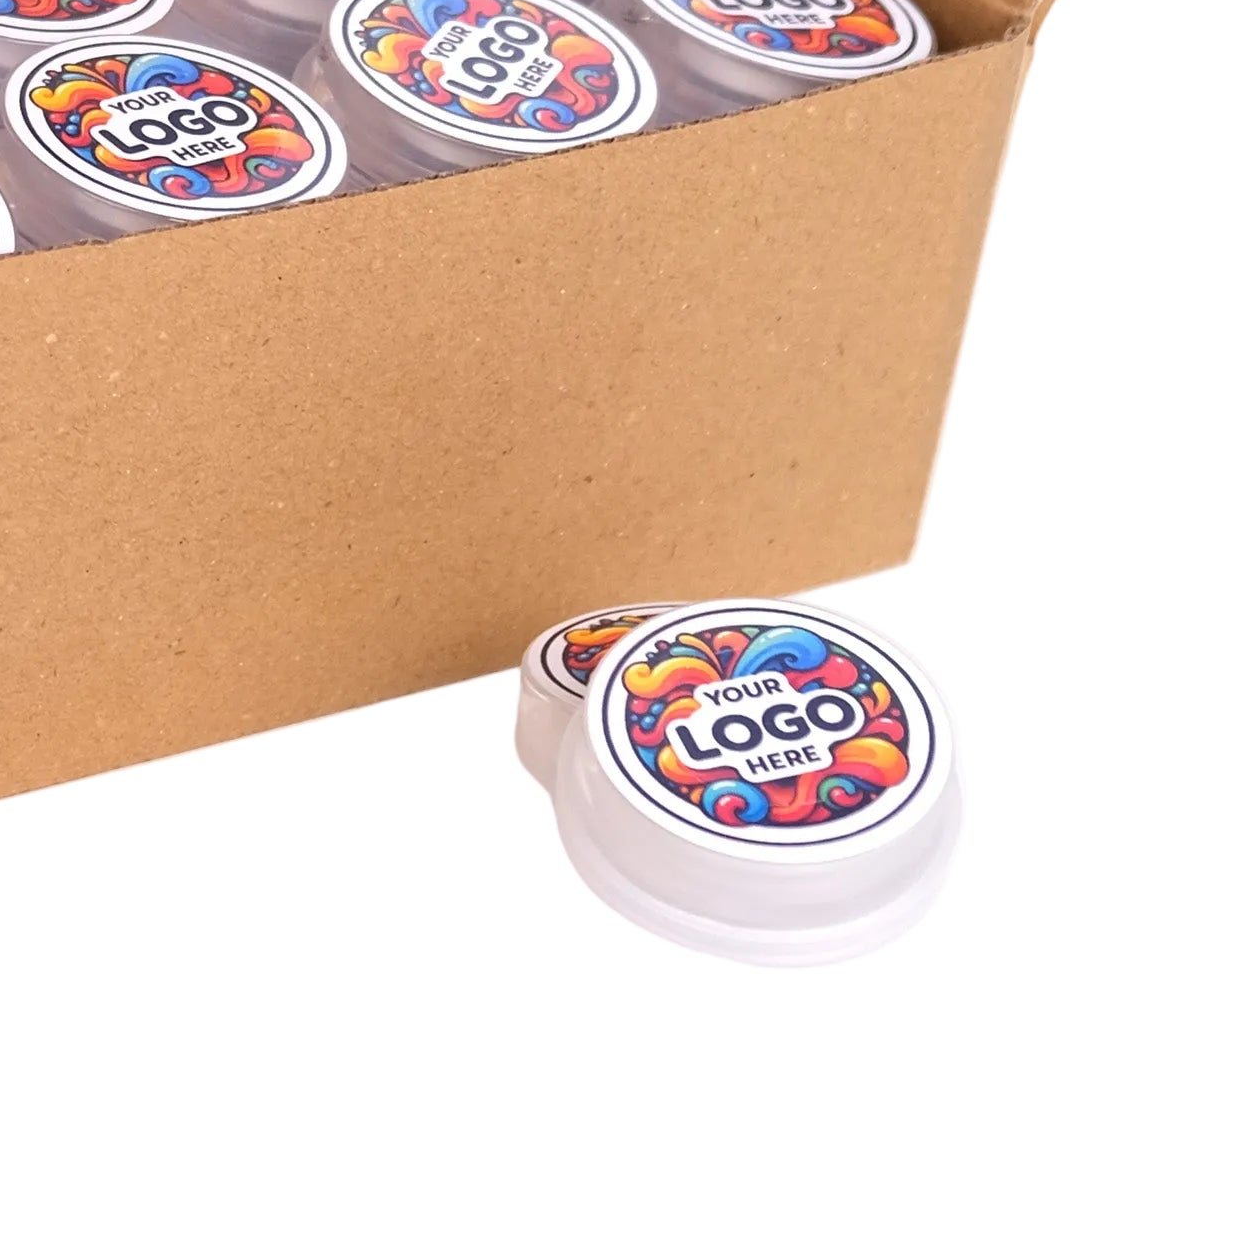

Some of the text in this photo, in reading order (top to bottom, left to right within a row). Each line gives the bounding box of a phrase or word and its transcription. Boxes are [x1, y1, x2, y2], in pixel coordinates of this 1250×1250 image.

[764, 13, 826, 25] HERE
[429, 25, 472, 59] YOUR
[446, 20, 540, 99] LOGO
[514, 57, 554, 92] HERE
[107, 90, 177, 114] YOUR
[99, 100, 250, 154] LOGO
[172, 136, 236, 161] HERE
[703, 677, 784, 706] YOUR
[675, 694, 856, 761] LOGO
[745, 745, 822, 775] HERE
